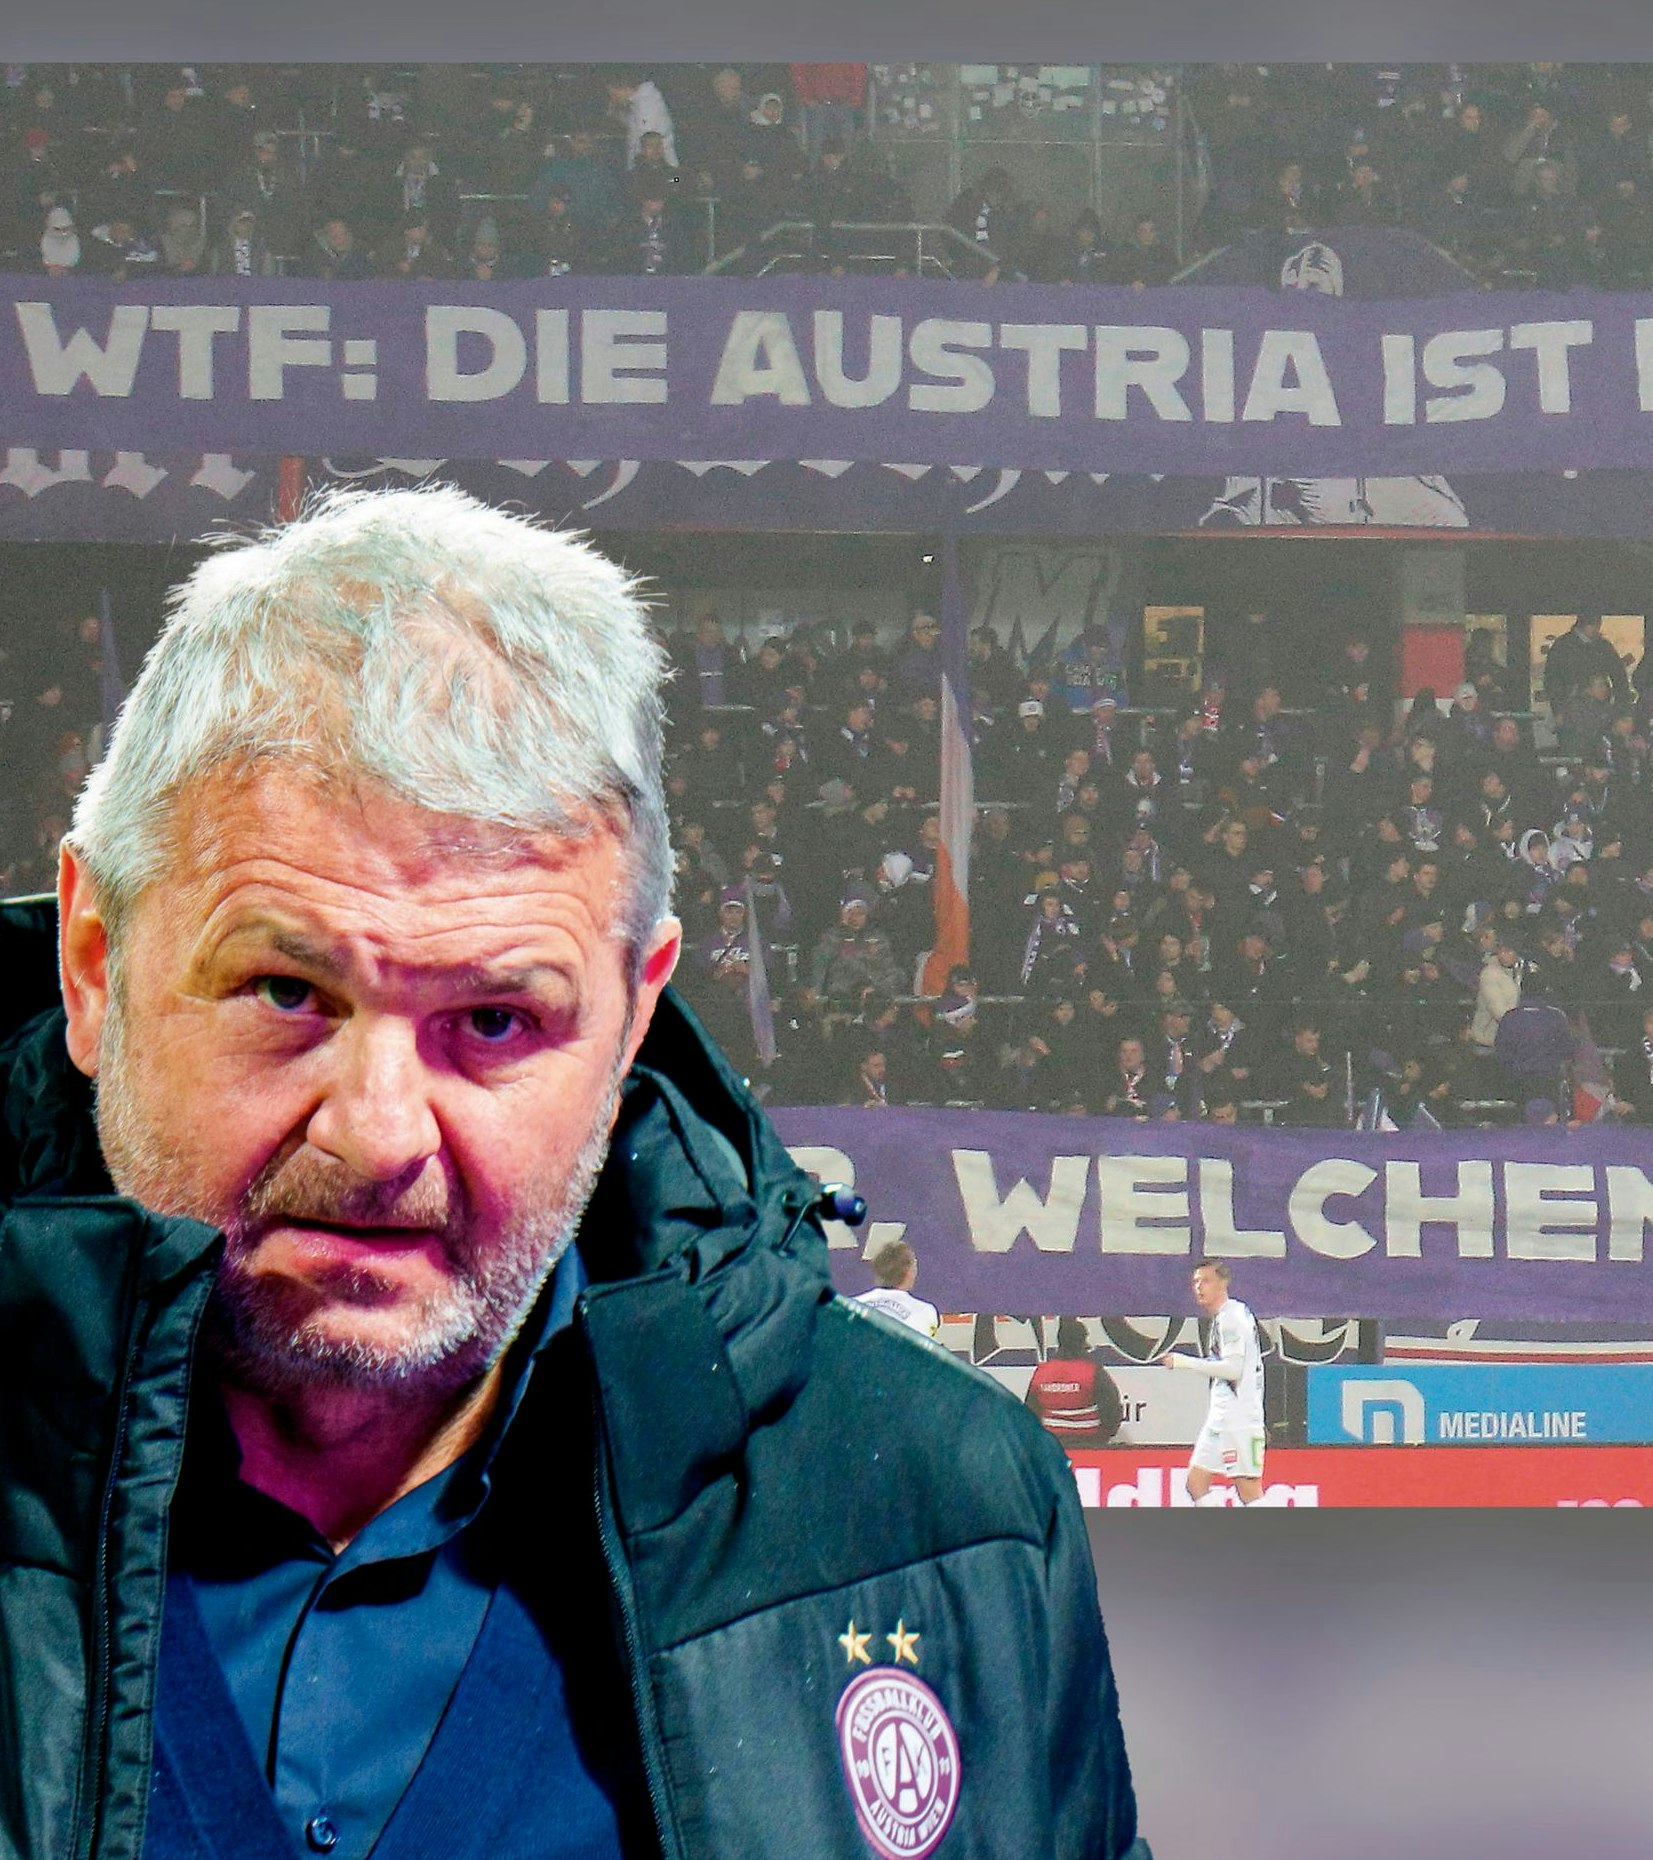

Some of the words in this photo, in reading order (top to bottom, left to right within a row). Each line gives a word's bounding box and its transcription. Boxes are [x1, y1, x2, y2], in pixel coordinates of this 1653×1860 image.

[16, 302, 377, 399] WTF:
[427, 305, 669, 404] DIE
[711, 310, 1342, 427] AUSTRIA
[1383, 320, 1593, 425] IST
[1439, 1411, 1587, 1439] MEDIALINE
[869, 1799, 916, 1849] AUSTRIA
